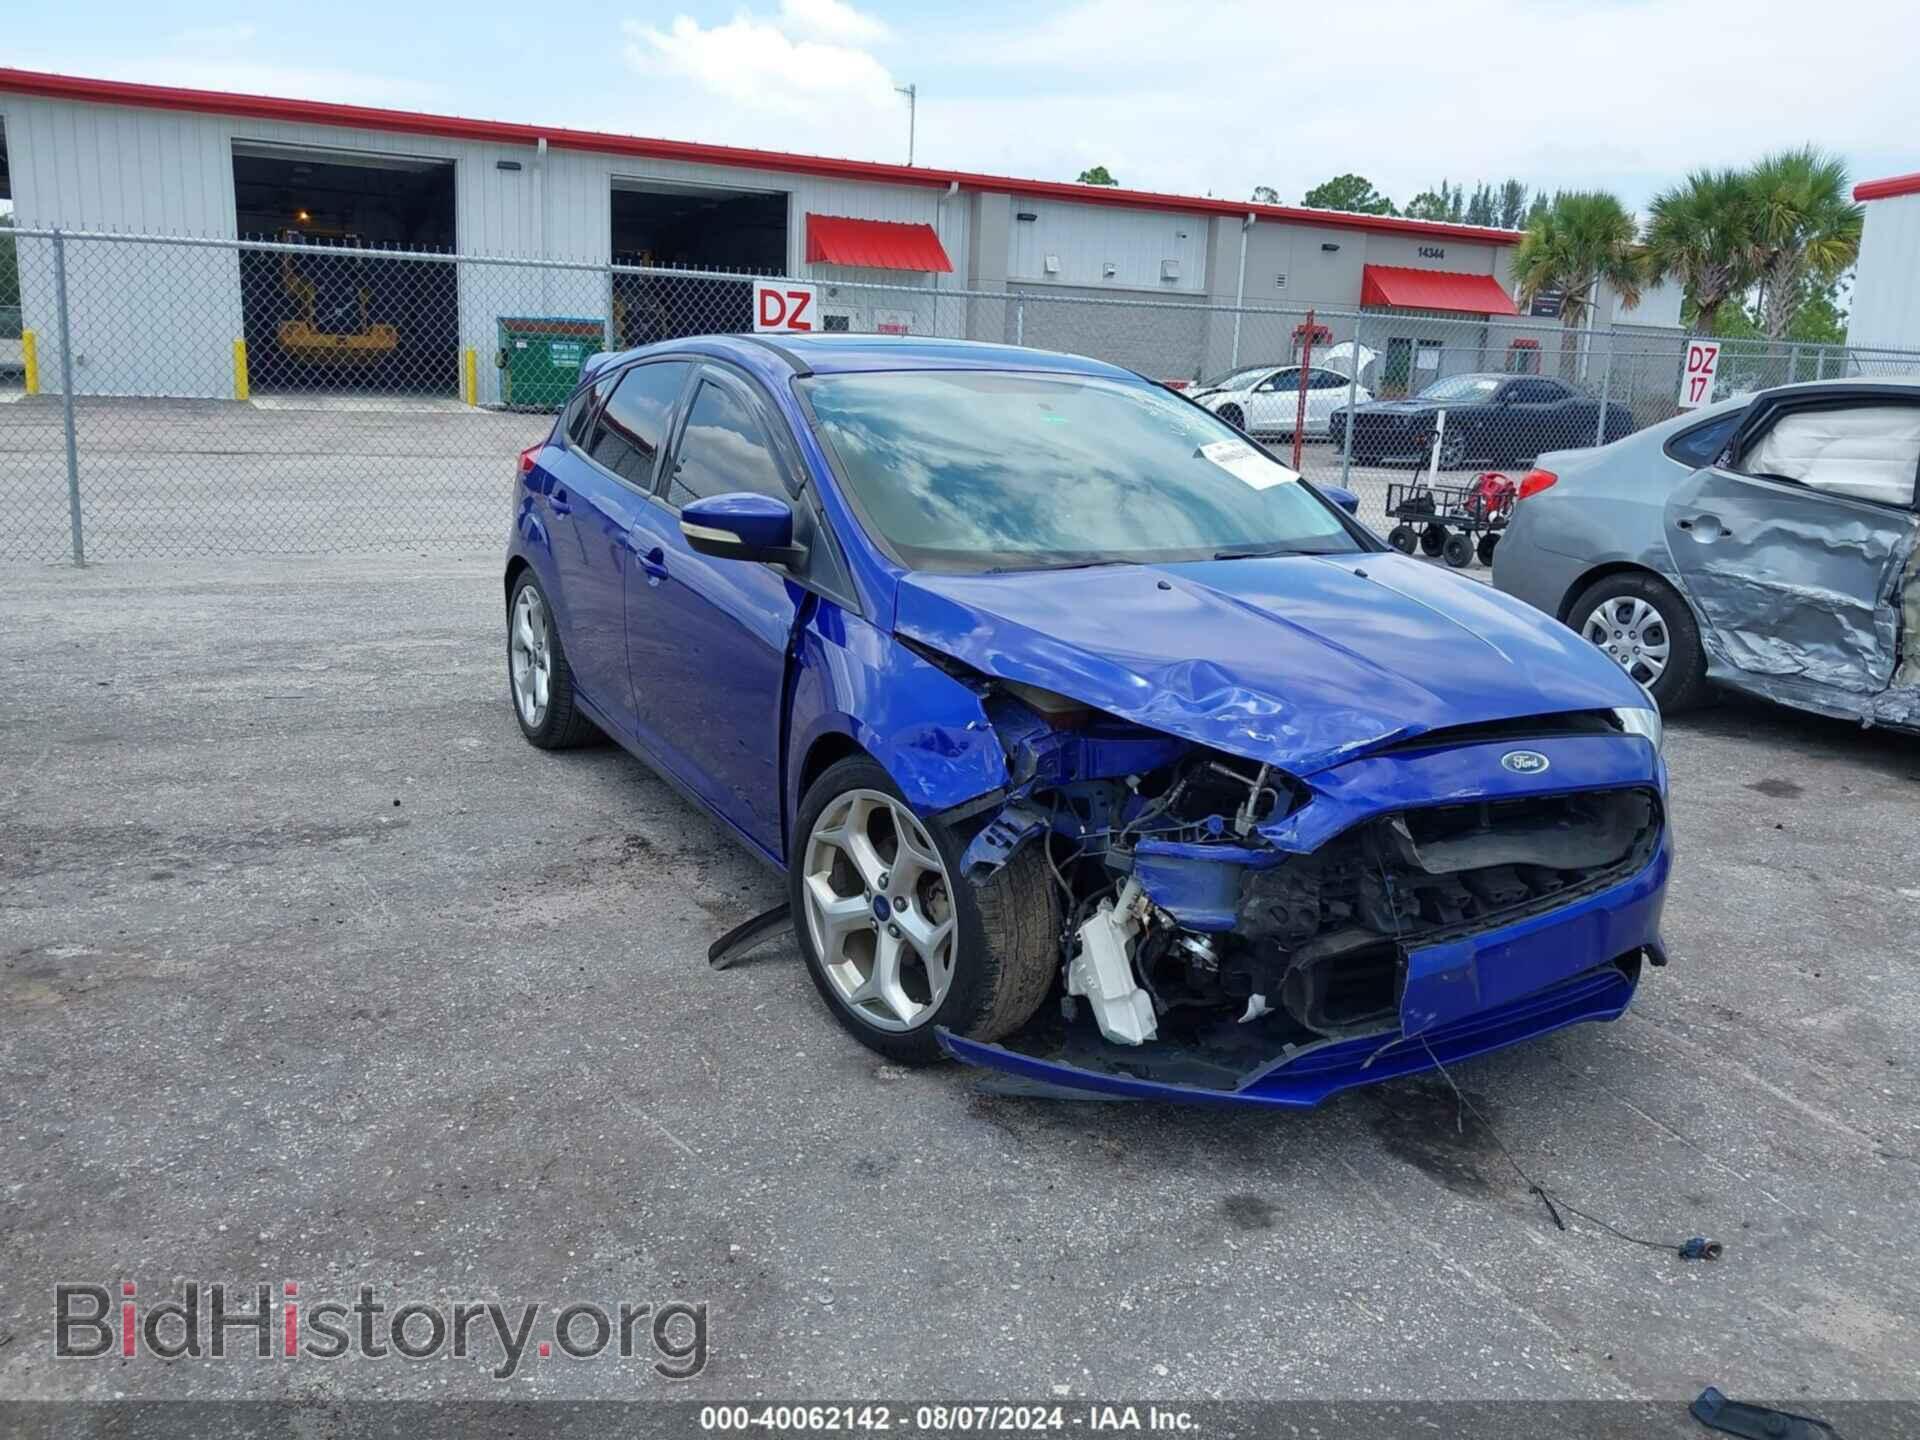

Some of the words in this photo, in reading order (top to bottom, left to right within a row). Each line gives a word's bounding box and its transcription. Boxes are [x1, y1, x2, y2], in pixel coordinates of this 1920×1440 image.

[1418, 246, 1444, 259] 14344
[760, 288, 811, 331] DZ
[1688, 346, 1717, 374] DZ
[1689, 377, 1707, 402] 17
[1512, 755, 1539, 769] Ford
